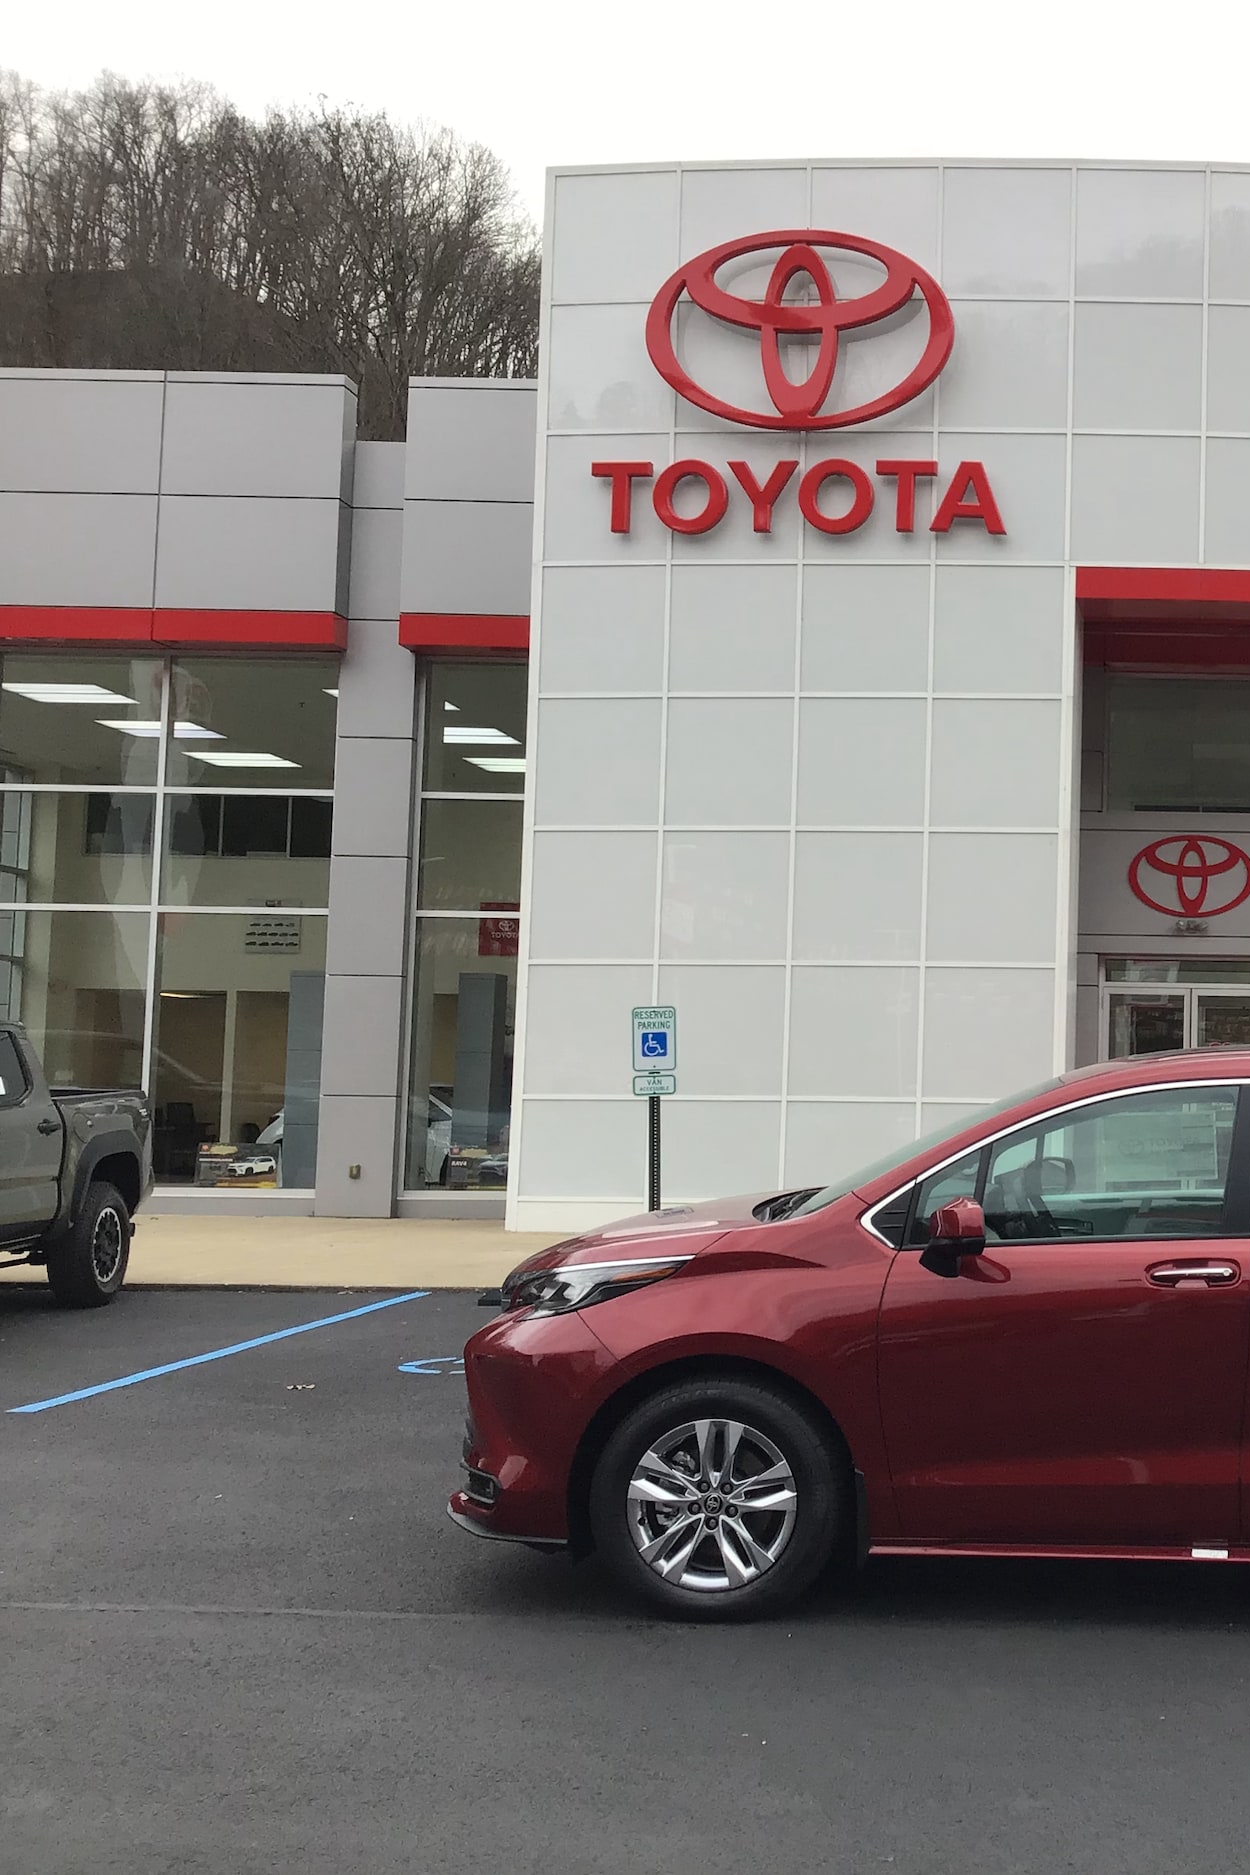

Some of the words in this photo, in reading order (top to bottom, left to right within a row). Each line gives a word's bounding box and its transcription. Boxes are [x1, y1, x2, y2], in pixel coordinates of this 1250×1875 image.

[592, 458, 1008, 536] TOYOTA
[634, 1010, 673, 1020] RESERVED
[637, 1021, 671, 1030] PARKING
